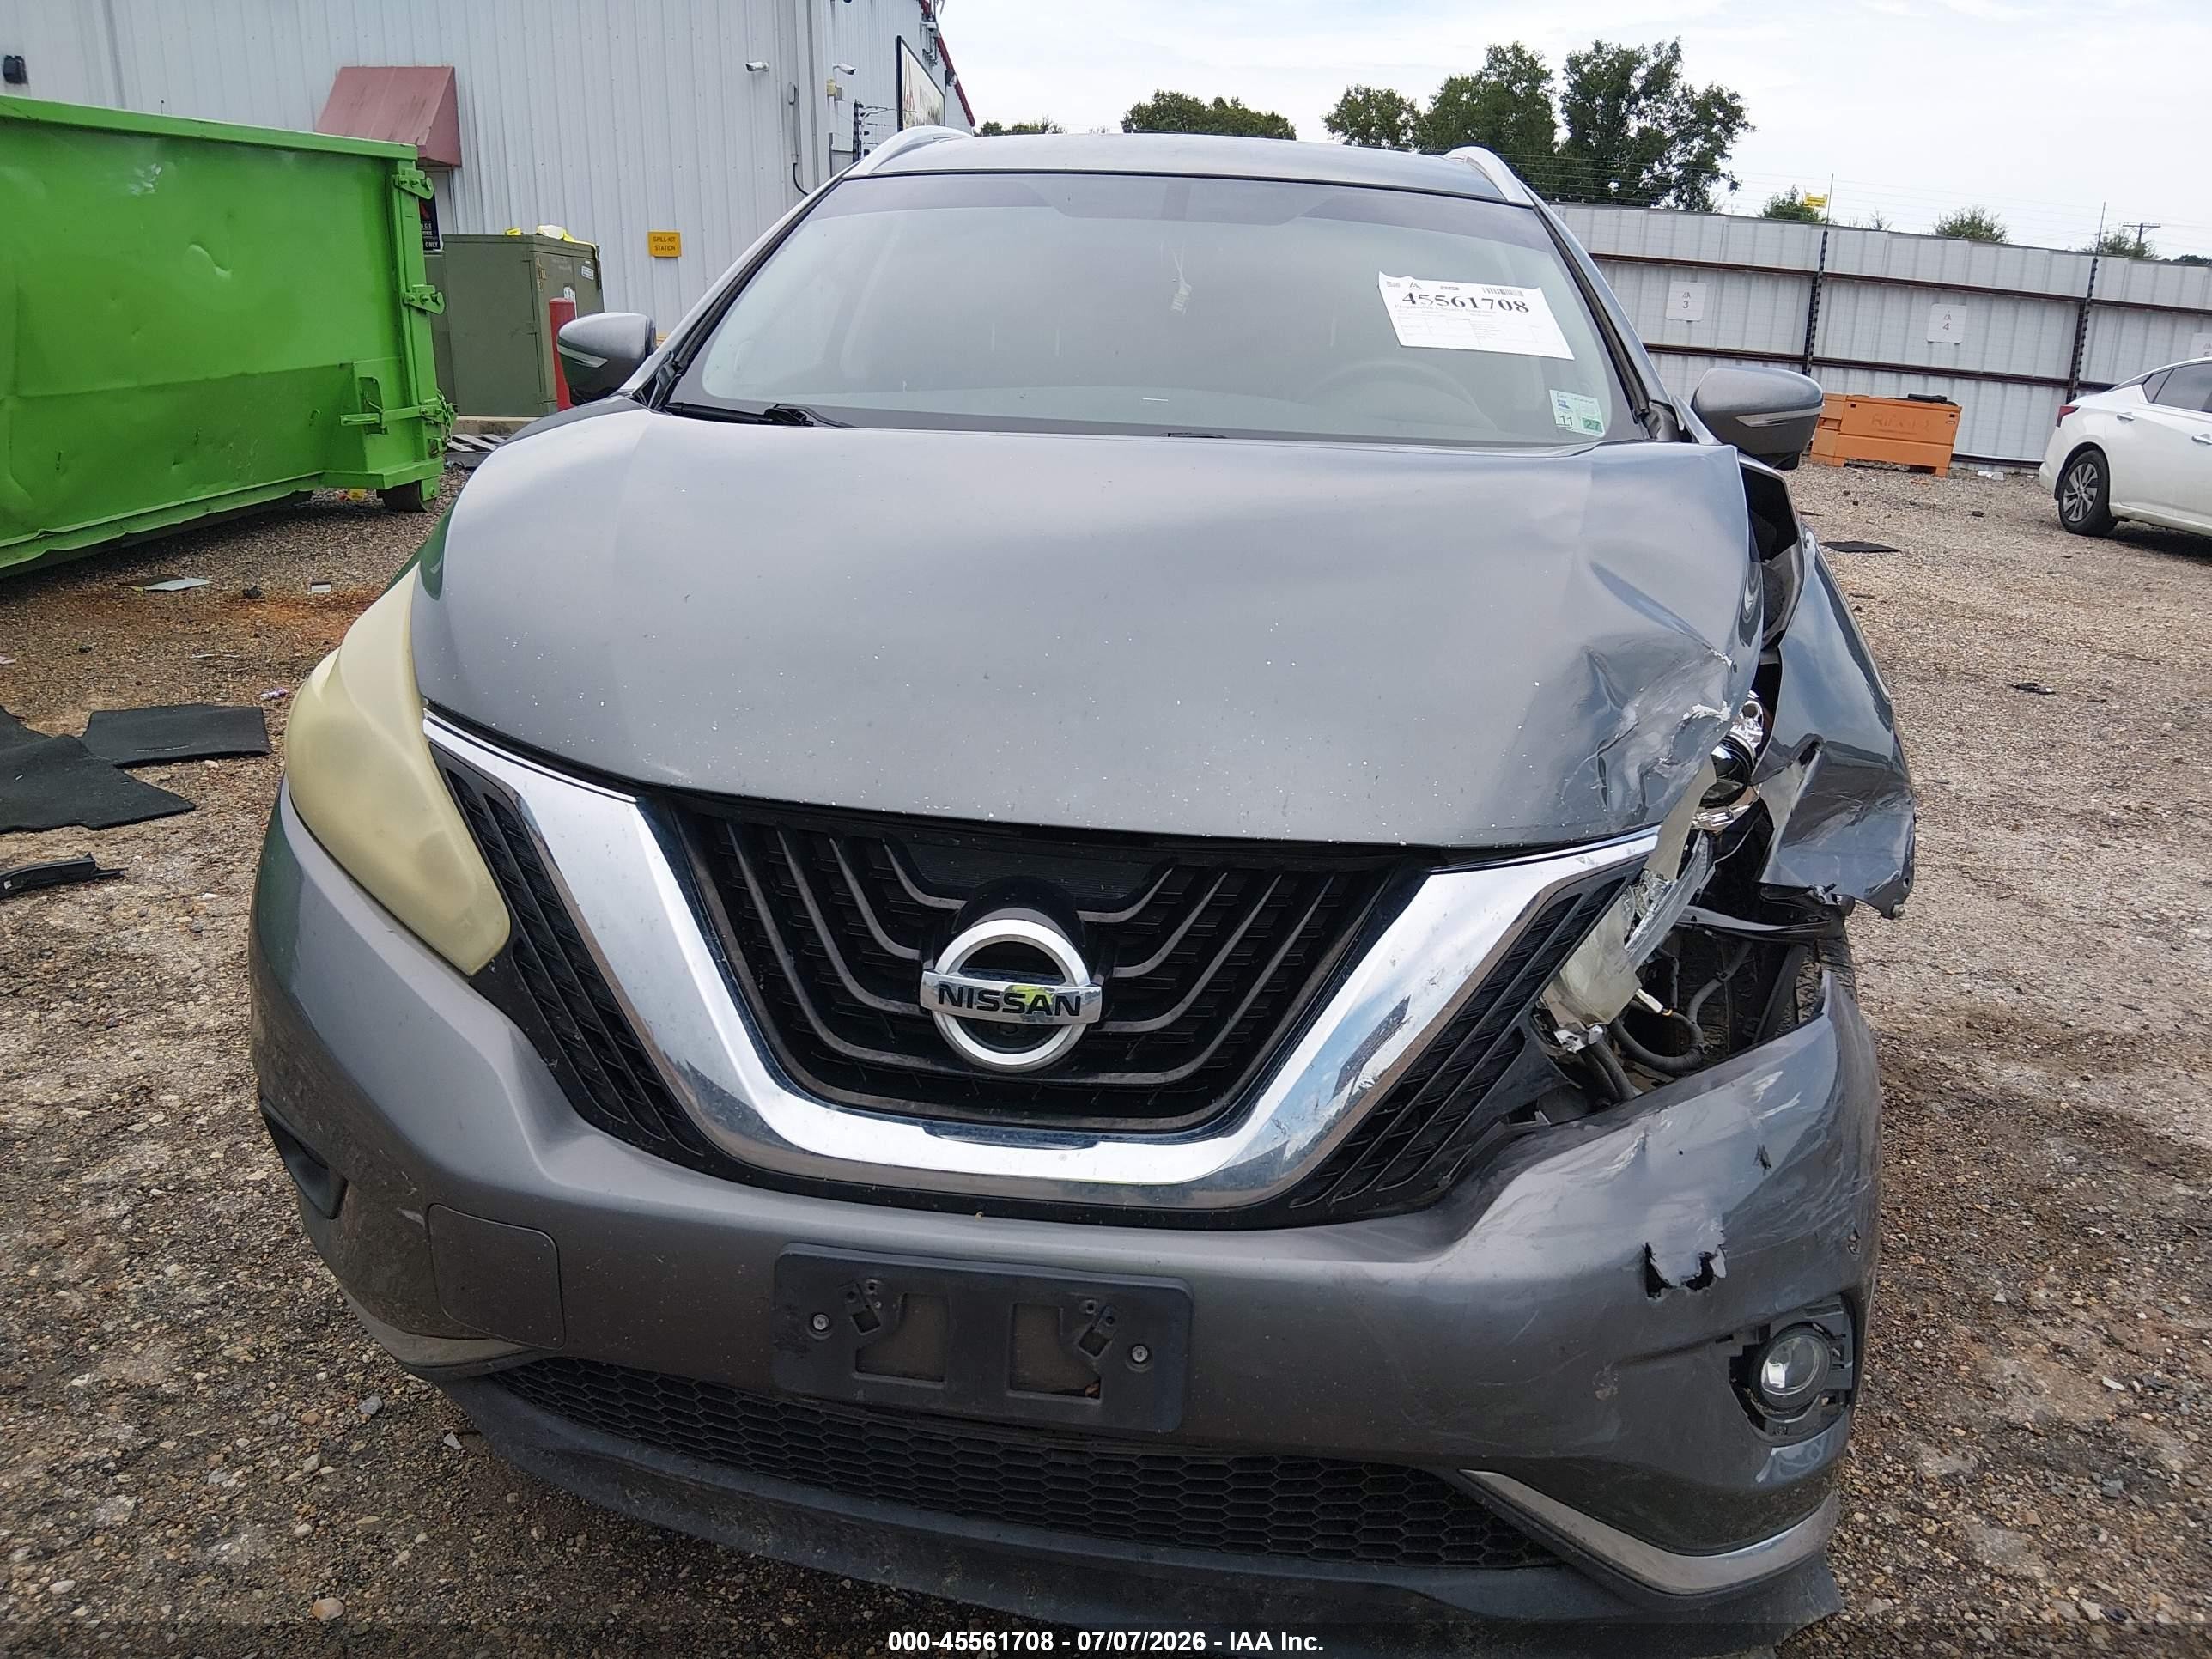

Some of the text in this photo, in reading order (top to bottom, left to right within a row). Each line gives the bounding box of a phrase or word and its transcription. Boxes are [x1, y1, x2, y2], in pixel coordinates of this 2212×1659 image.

[1402, 292, 1530, 314] 45561708
[1682, 300, 1689, 309] 3
[1942, 322, 1950, 331] 4
[1559, 415, 1573, 426] 11
[1585, 419, 1601, 431] 27
[938, 981, 1081, 1017] NISSAN
